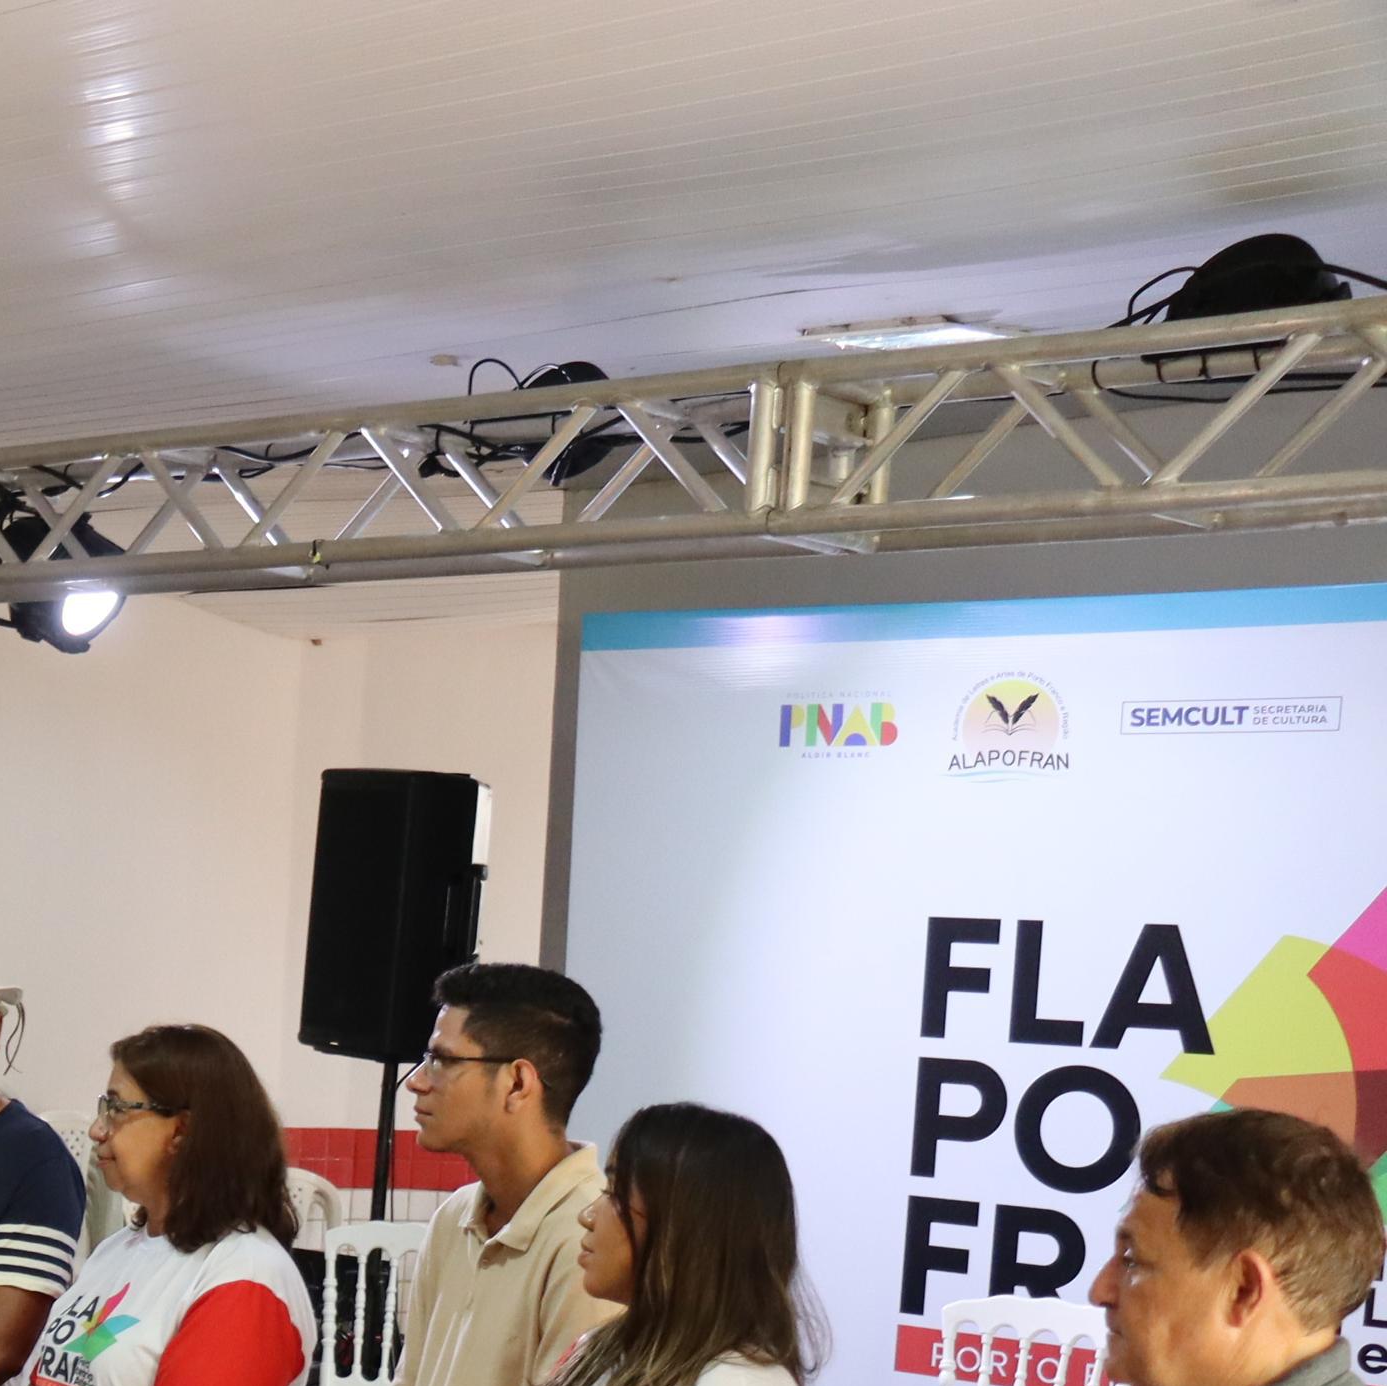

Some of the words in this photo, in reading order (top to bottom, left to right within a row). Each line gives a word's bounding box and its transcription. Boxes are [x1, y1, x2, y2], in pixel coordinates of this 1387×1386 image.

[1130, 705, 1249, 728] SEMCULT
[1252, 703, 1328, 716] SECRETARIA
[1252, 716, 1269, 726] DE
[1272, 714, 1328, 726] CULTURA
[779, 702, 898, 748] PNAB
[947, 748, 1070, 771] ALAPOFRAN
[920, 916, 1215, 1055] FLA
[910, 1056, 1141, 1194] PO
[899, 1195, 1086, 1316] FR
[59, 1295, 100, 1322] LA
